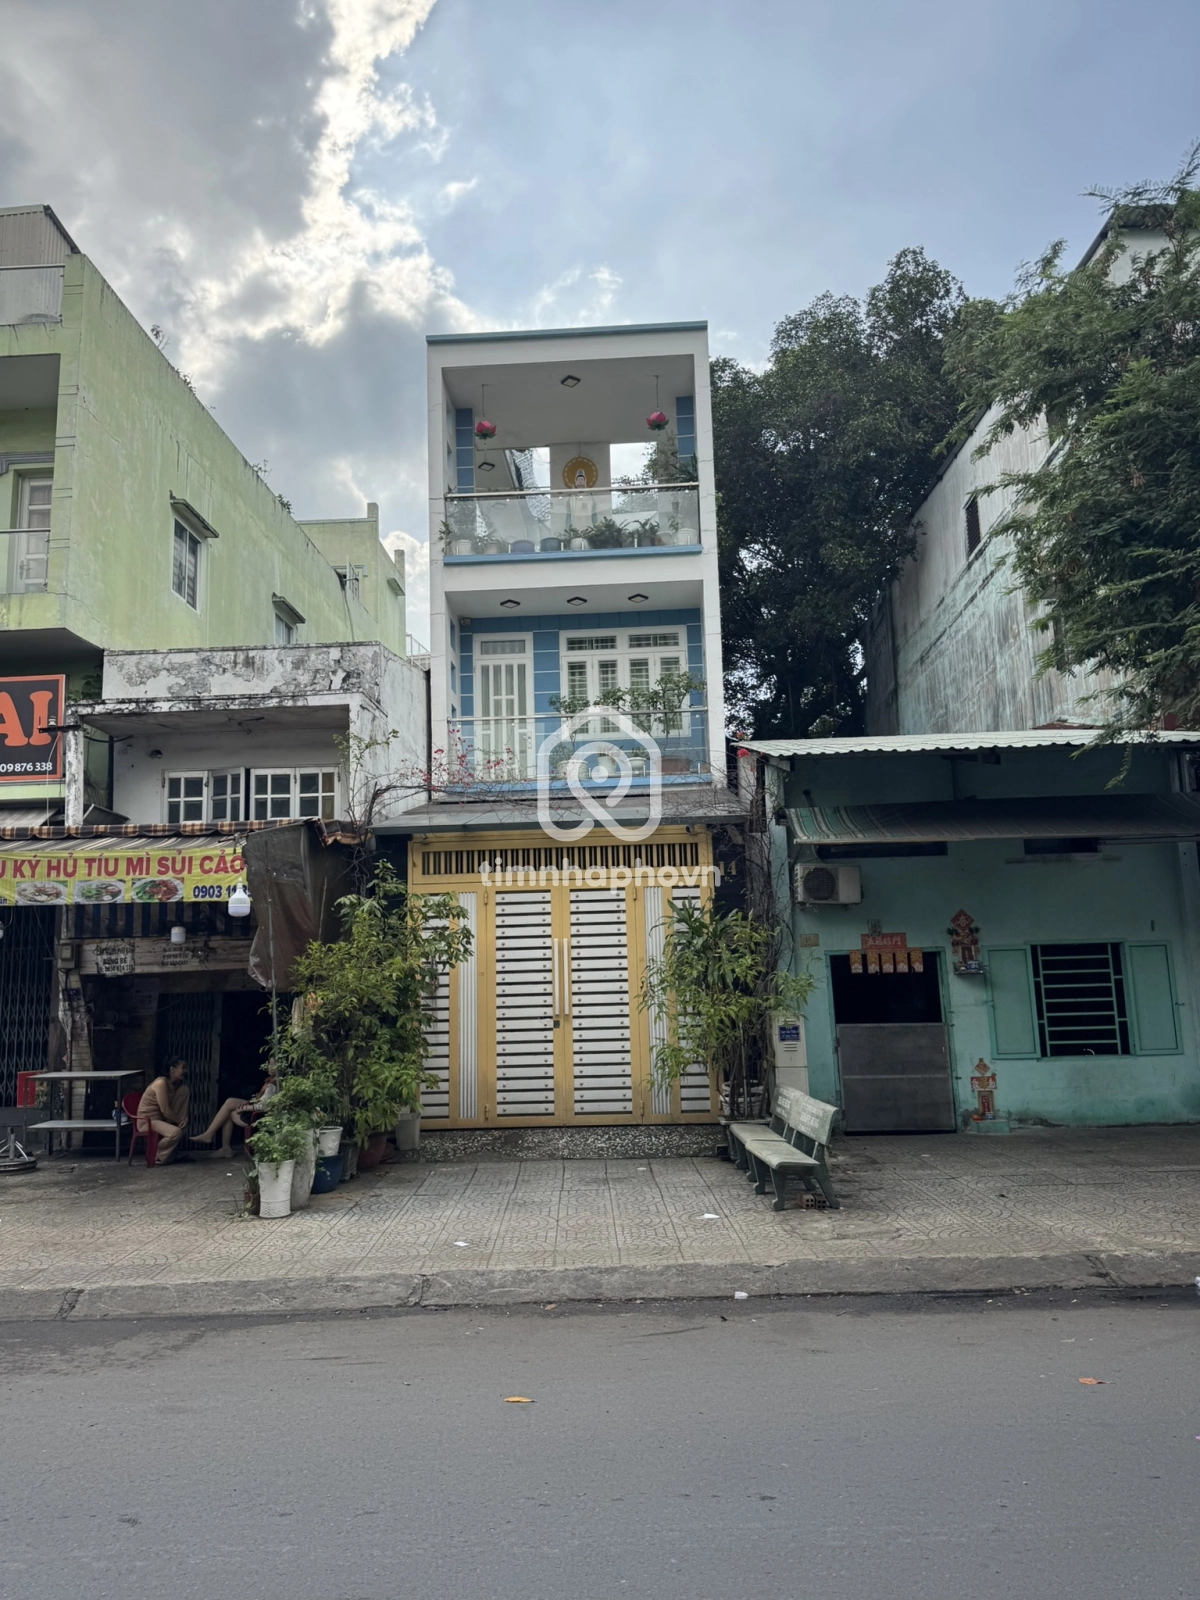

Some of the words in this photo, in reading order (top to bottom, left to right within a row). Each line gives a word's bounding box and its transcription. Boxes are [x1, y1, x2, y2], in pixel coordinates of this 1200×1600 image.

[12, 854, 41, 879] KÝ
[46, 852, 78, 878] HỦ
[84, 853, 119, 877] TÍU
[125, 851, 151, 876] MÌ
[156, 849, 193, 875] SỦI
[199, 849, 246, 875] CẢO
[193, 885, 222, 899] 0903
